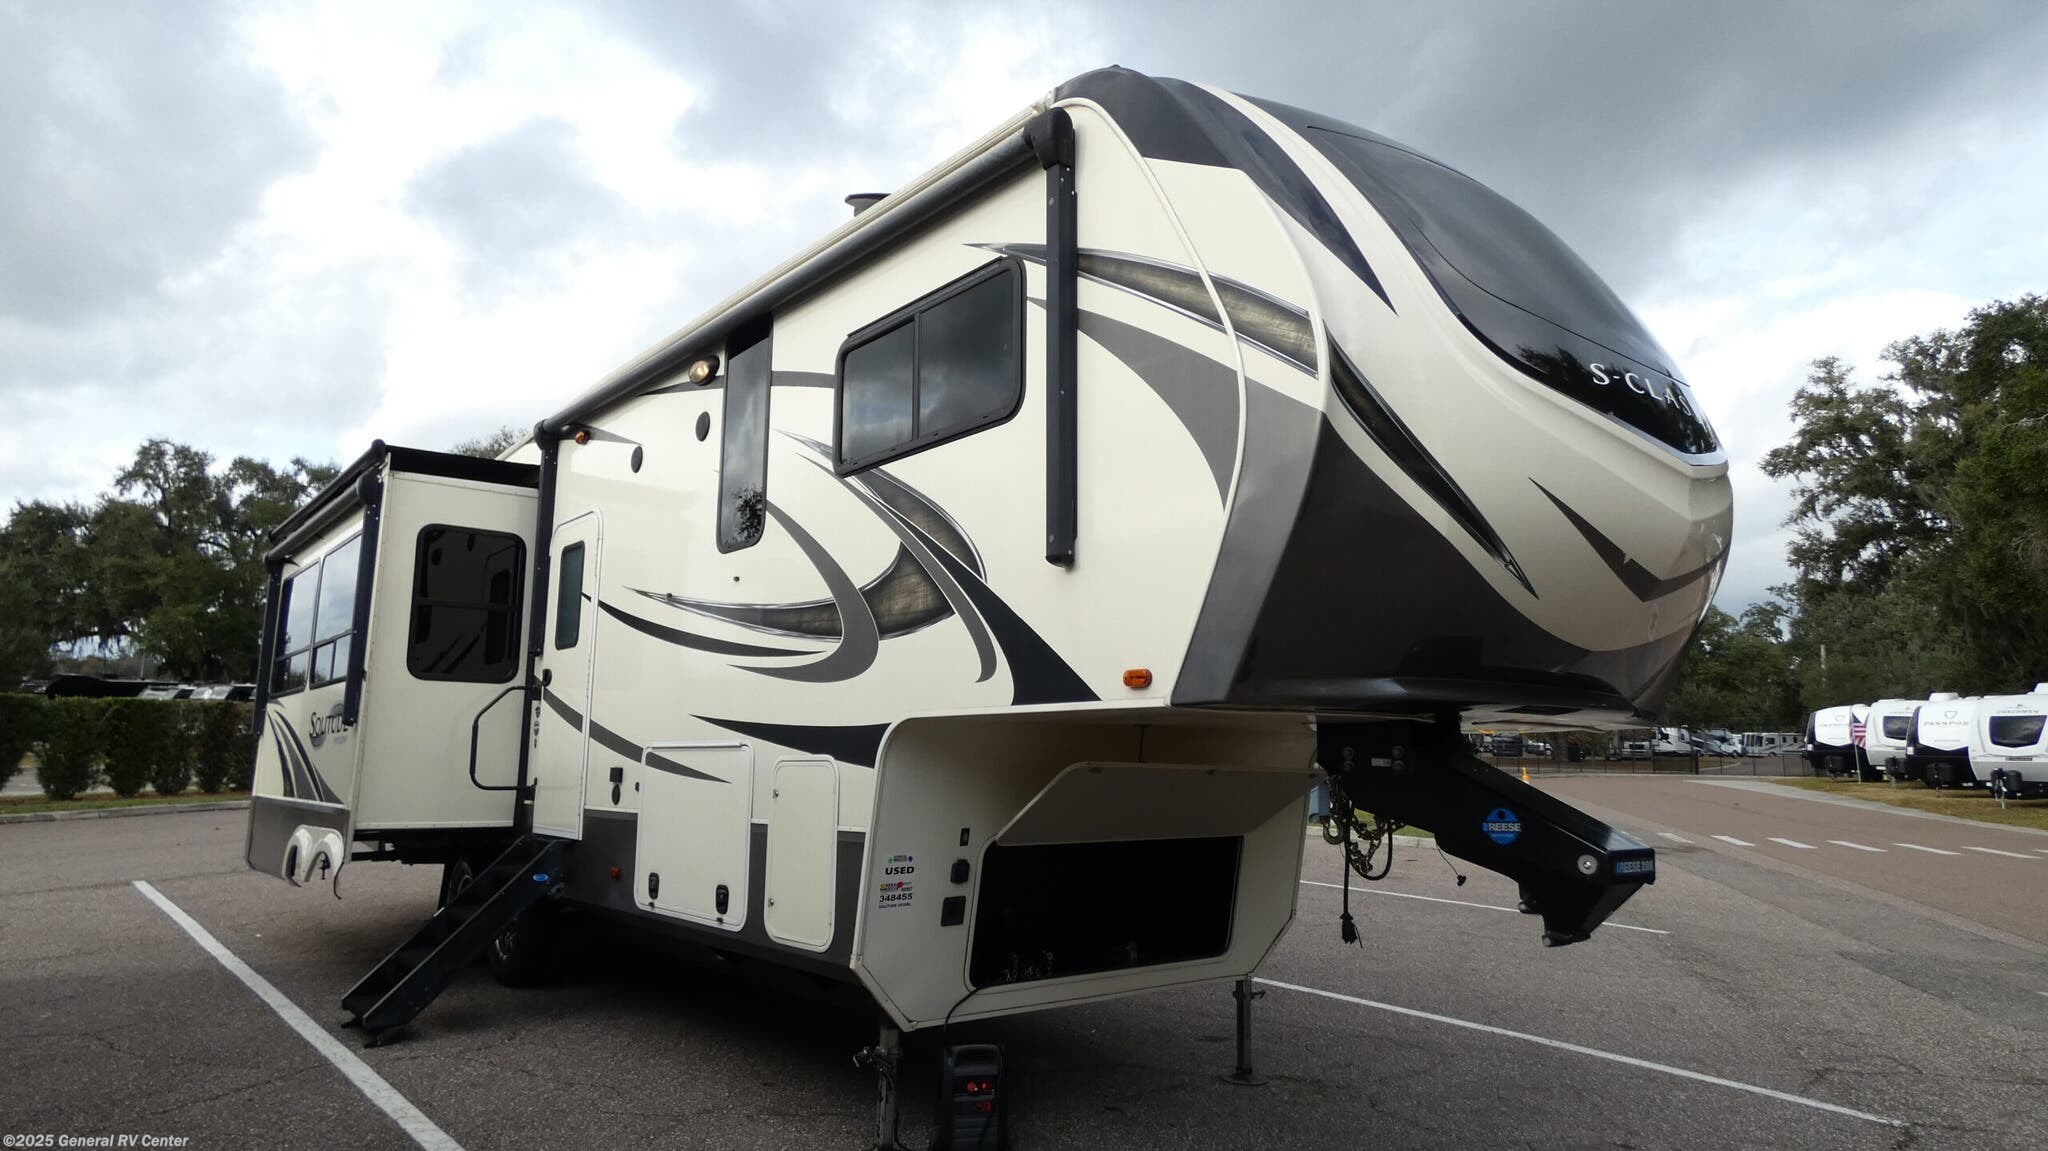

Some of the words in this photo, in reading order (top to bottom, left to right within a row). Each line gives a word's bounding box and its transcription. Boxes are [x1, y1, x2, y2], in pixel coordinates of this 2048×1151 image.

[1488, 822, 1521, 832] REESE
[885, 866, 915, 875] USED
[879, 892, 913, 903] 348455
